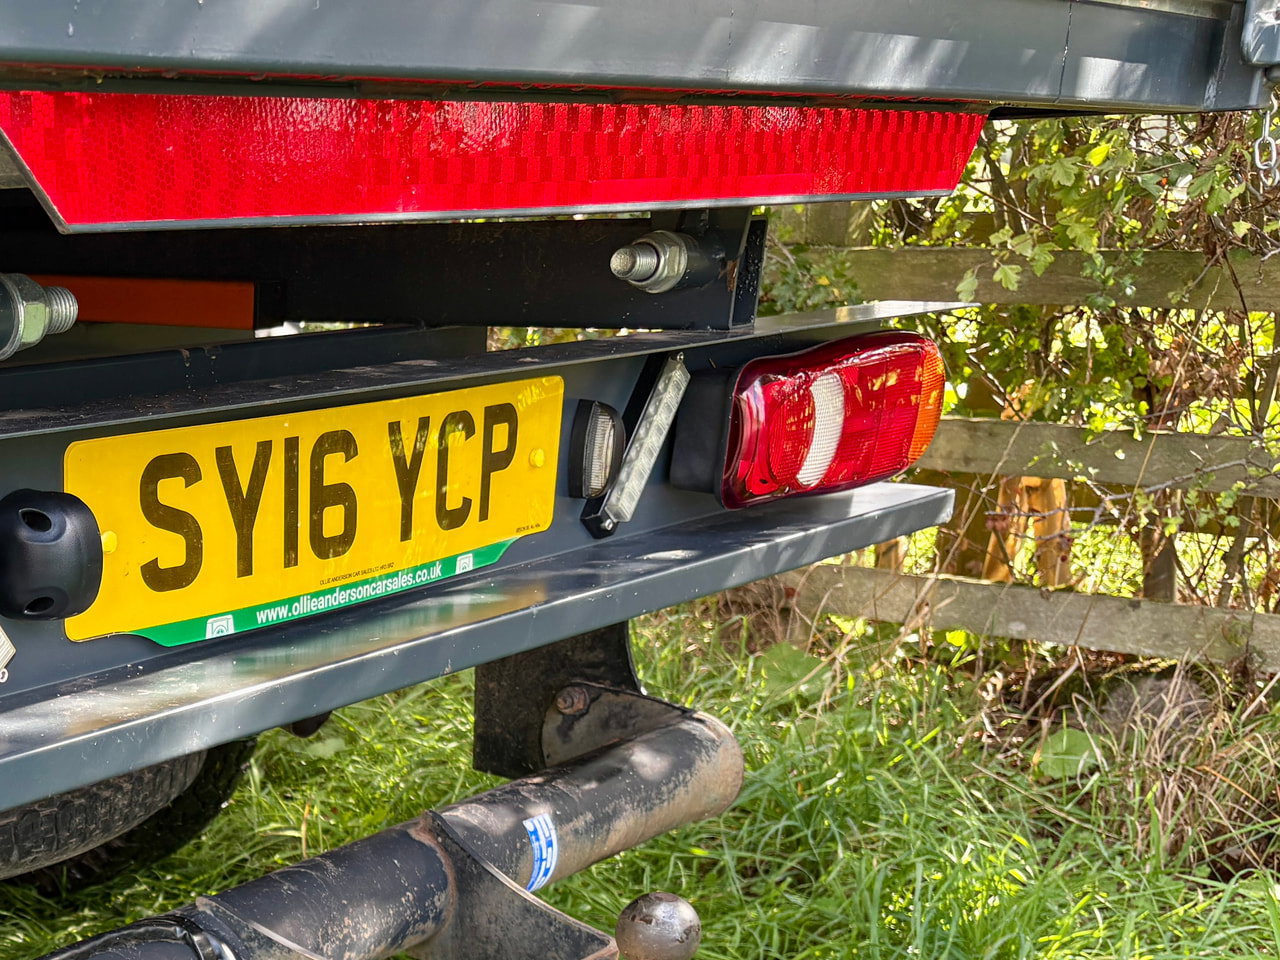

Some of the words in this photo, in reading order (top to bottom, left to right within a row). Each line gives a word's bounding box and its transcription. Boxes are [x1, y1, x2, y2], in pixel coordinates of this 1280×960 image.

[139, 429, 358, 592] SY16
[387, 402, 518, 542] YCP
[256, 561, 442, 625] www.ollieandersoncarsales.co.uk
